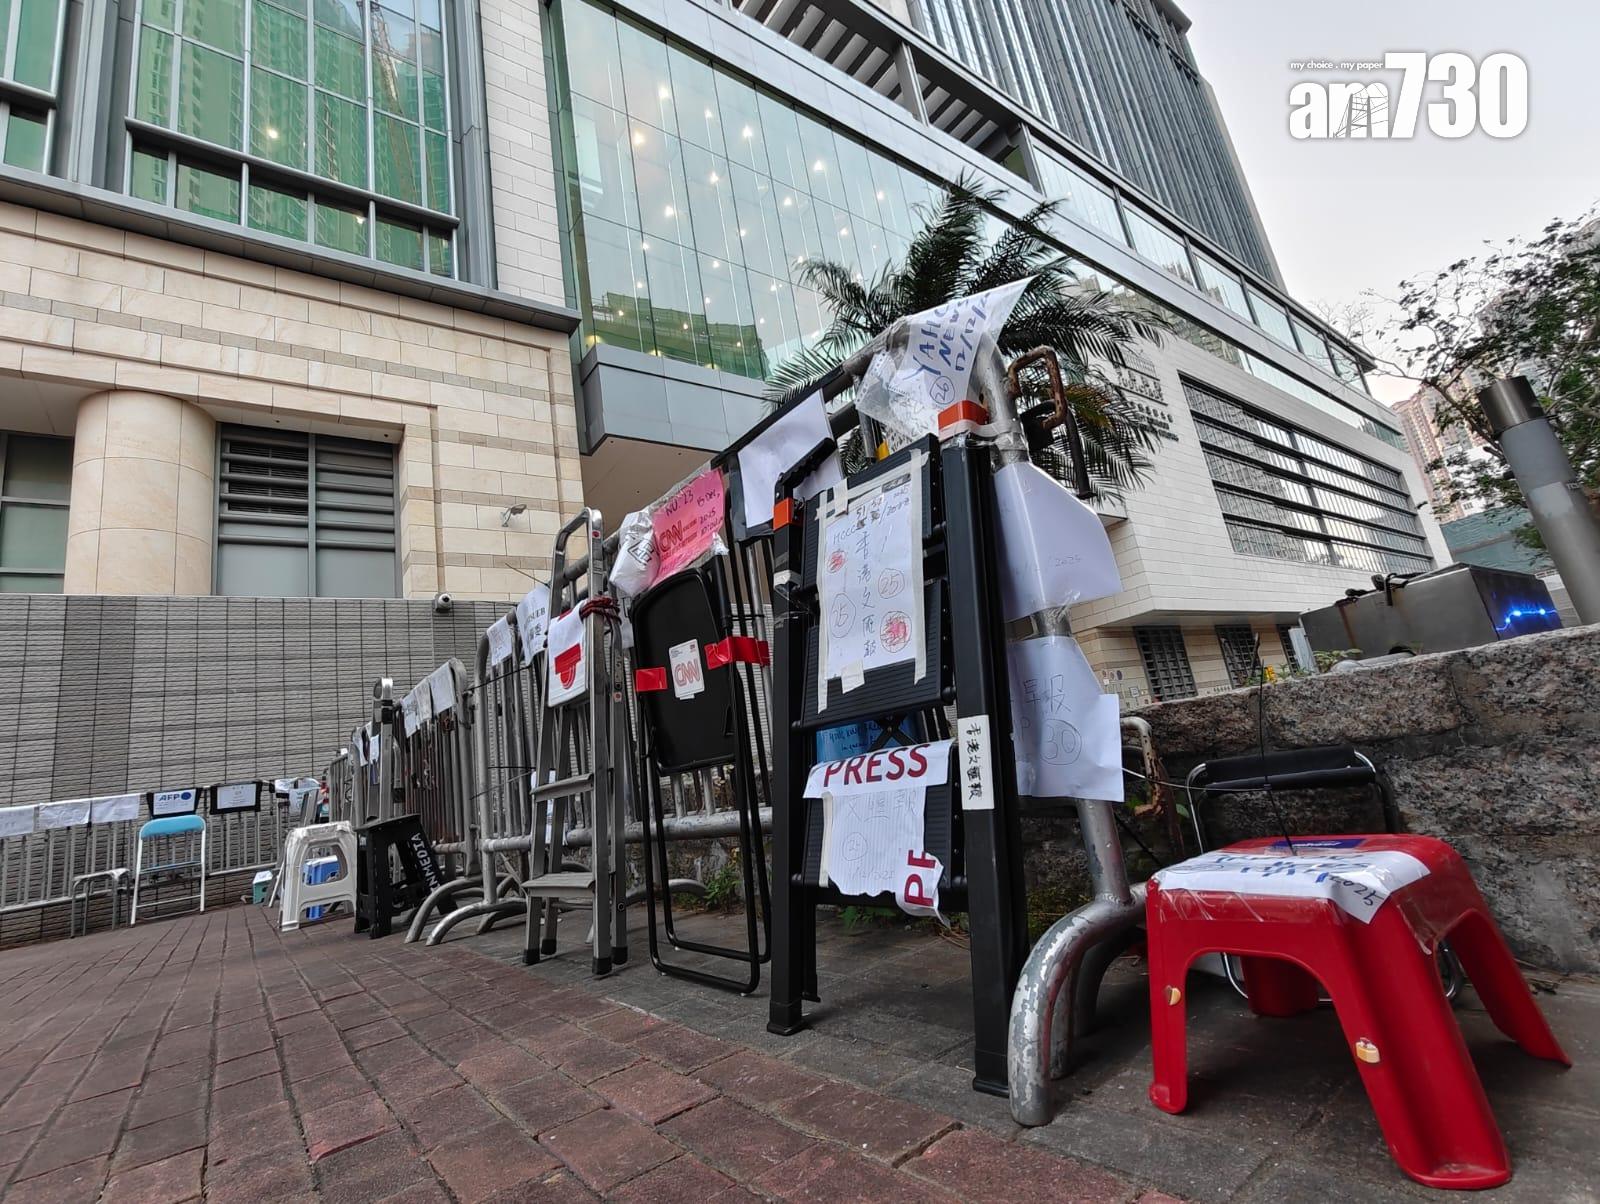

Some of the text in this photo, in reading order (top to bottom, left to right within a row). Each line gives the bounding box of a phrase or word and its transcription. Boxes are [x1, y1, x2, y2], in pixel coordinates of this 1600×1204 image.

[658, 520, 683, 553] CNN
[674, 659, 702, 687] CNN
[823, 743, 930, 788] PRESS
[159, 792, 181, 802] AFP
[411, 831, 440, 893] INMEDIA
